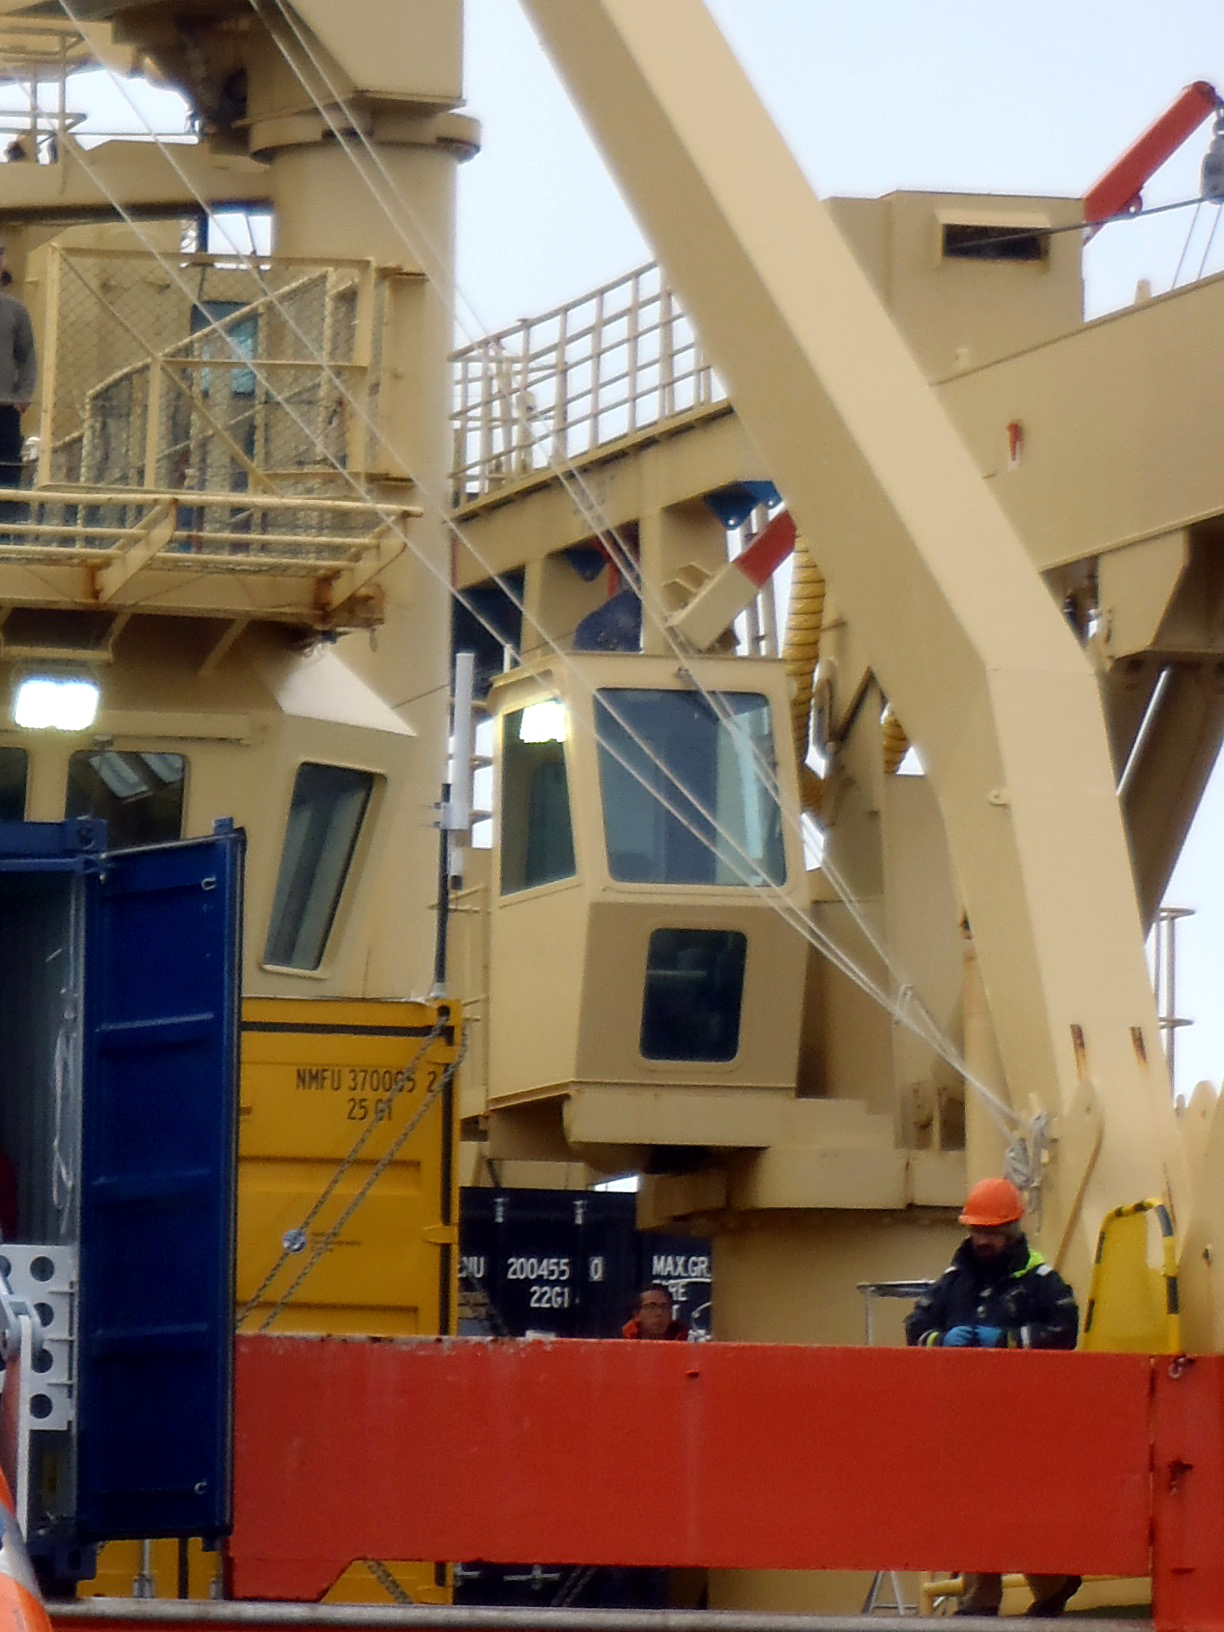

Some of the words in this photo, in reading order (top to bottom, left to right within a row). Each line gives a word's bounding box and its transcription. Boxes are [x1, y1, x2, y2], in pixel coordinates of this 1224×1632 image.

[296, 1068, 341, 1091] NMFU
[347, 1098, 368, 1120] 25
[507, 1257, 569, 1280] 200455
